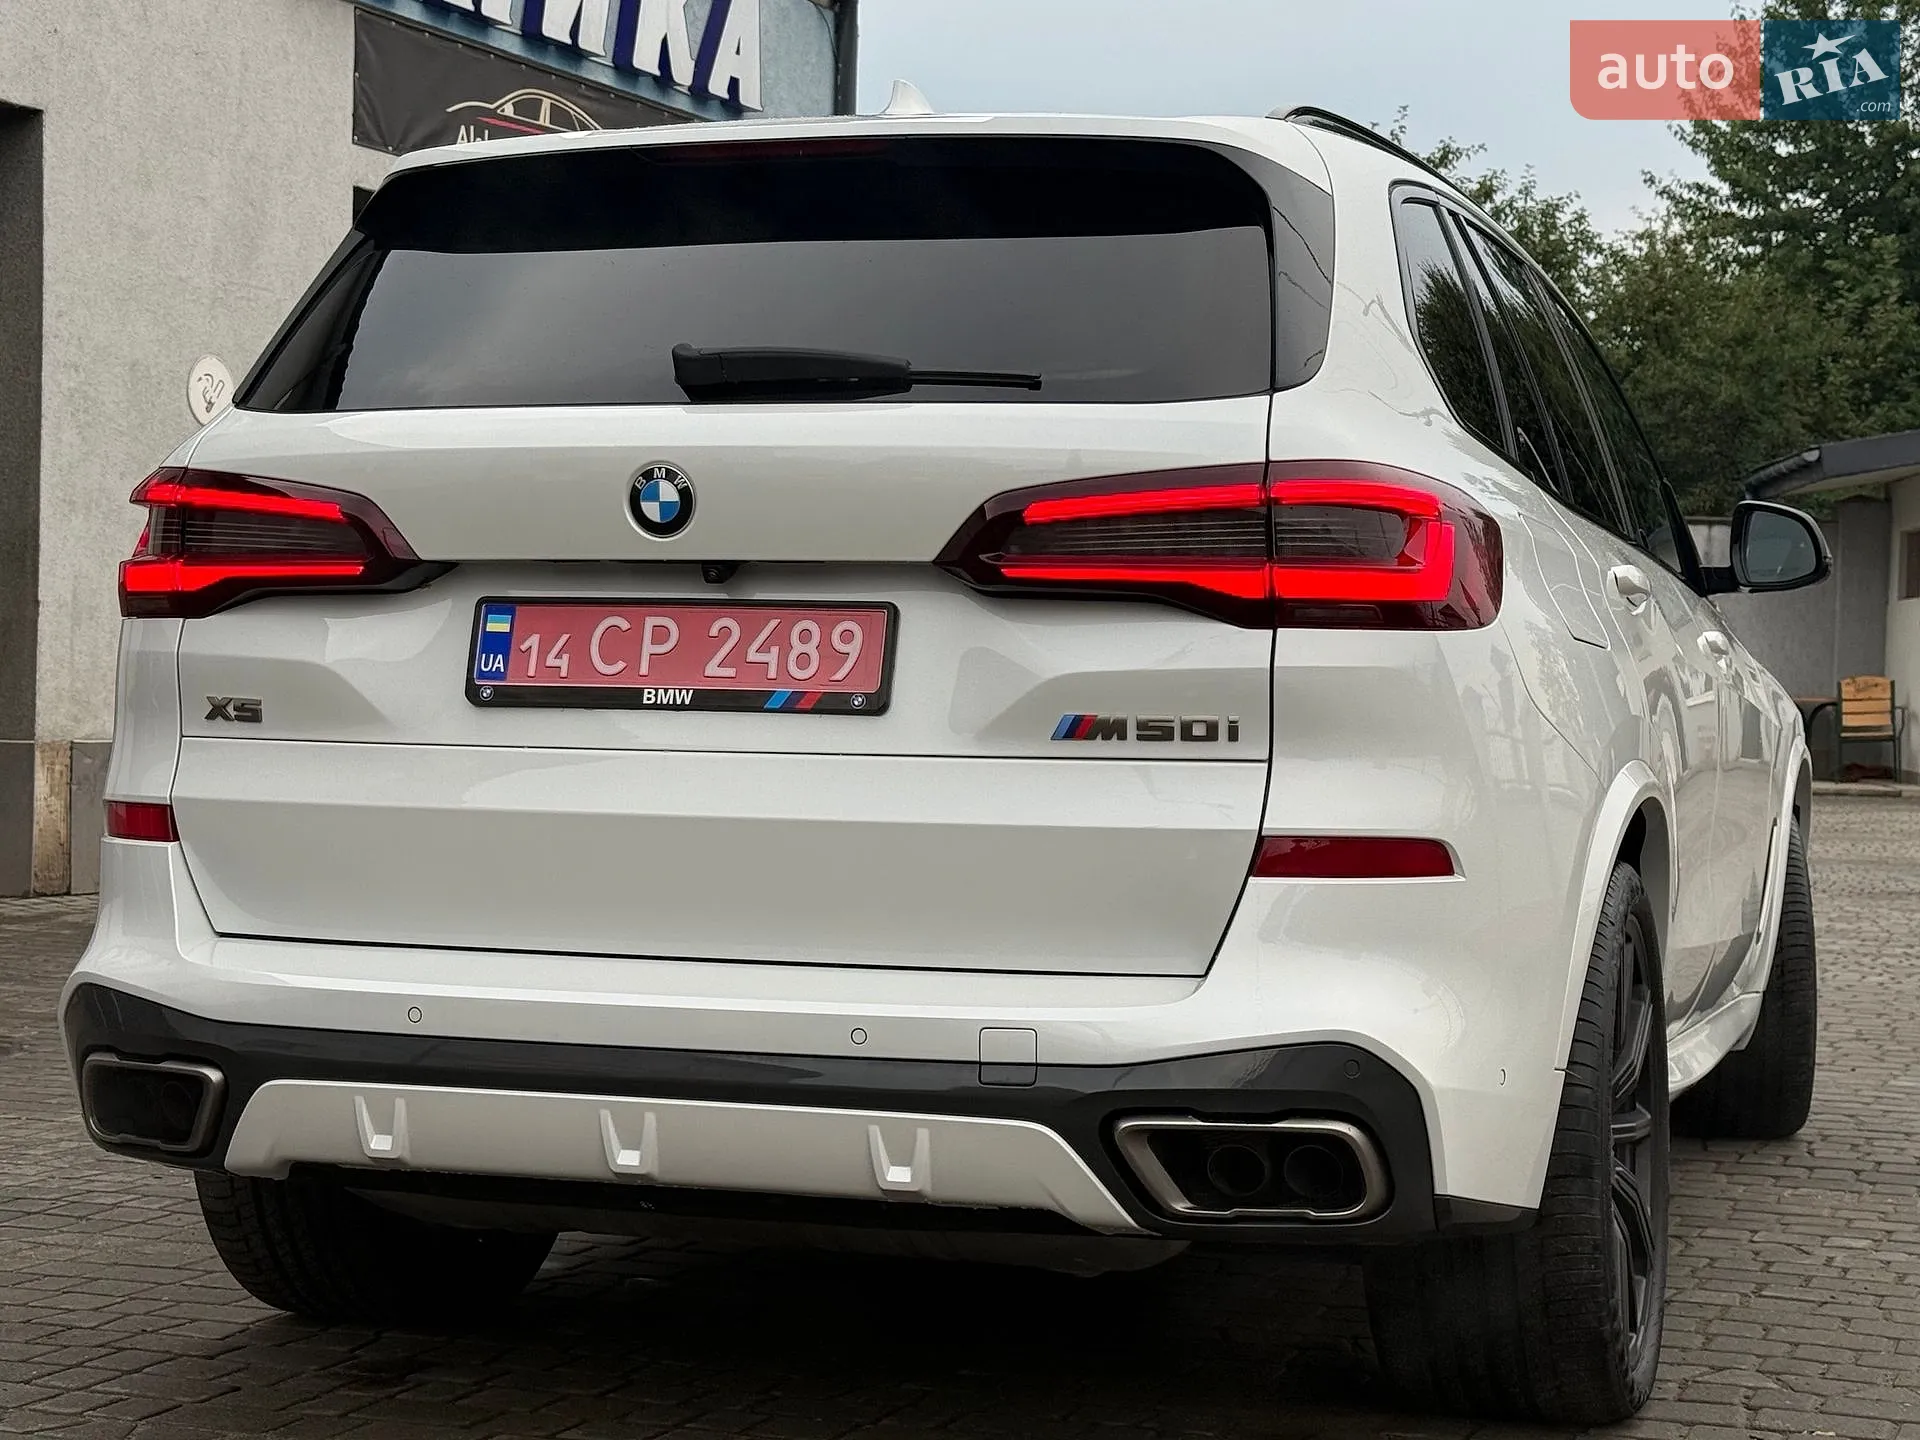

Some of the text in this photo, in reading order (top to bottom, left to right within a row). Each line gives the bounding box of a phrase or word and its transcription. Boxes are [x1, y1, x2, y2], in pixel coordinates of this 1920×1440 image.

[634, 467, 688, 490] BMW
[519, 615, 864, 682] 14 CP 2489
[481, 653, 505, 673] UA
[642, 688, 694, 706] BMW
[204, 696, 263, 723] X5
